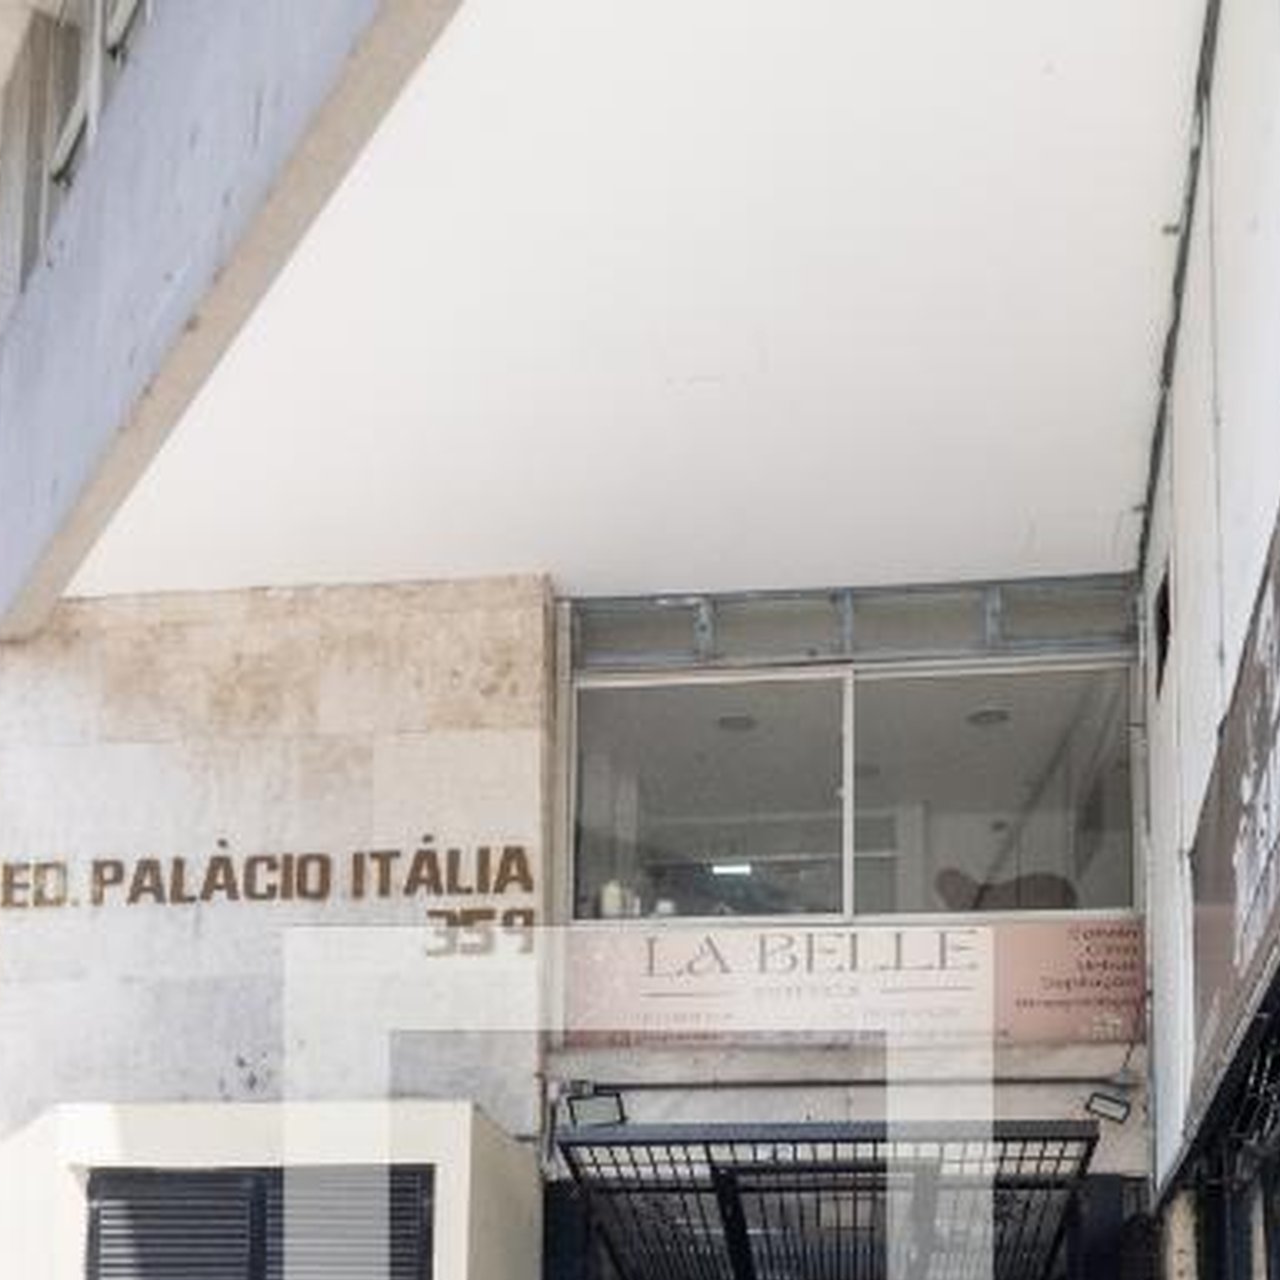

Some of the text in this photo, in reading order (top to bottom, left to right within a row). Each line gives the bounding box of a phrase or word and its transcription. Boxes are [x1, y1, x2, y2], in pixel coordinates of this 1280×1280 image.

[0, 834, 535, 909] ED. PALÁCIO ITÁLIA
[425, 908, 535, 957] 359
[641, 929, 980, 978] LA BELLE
